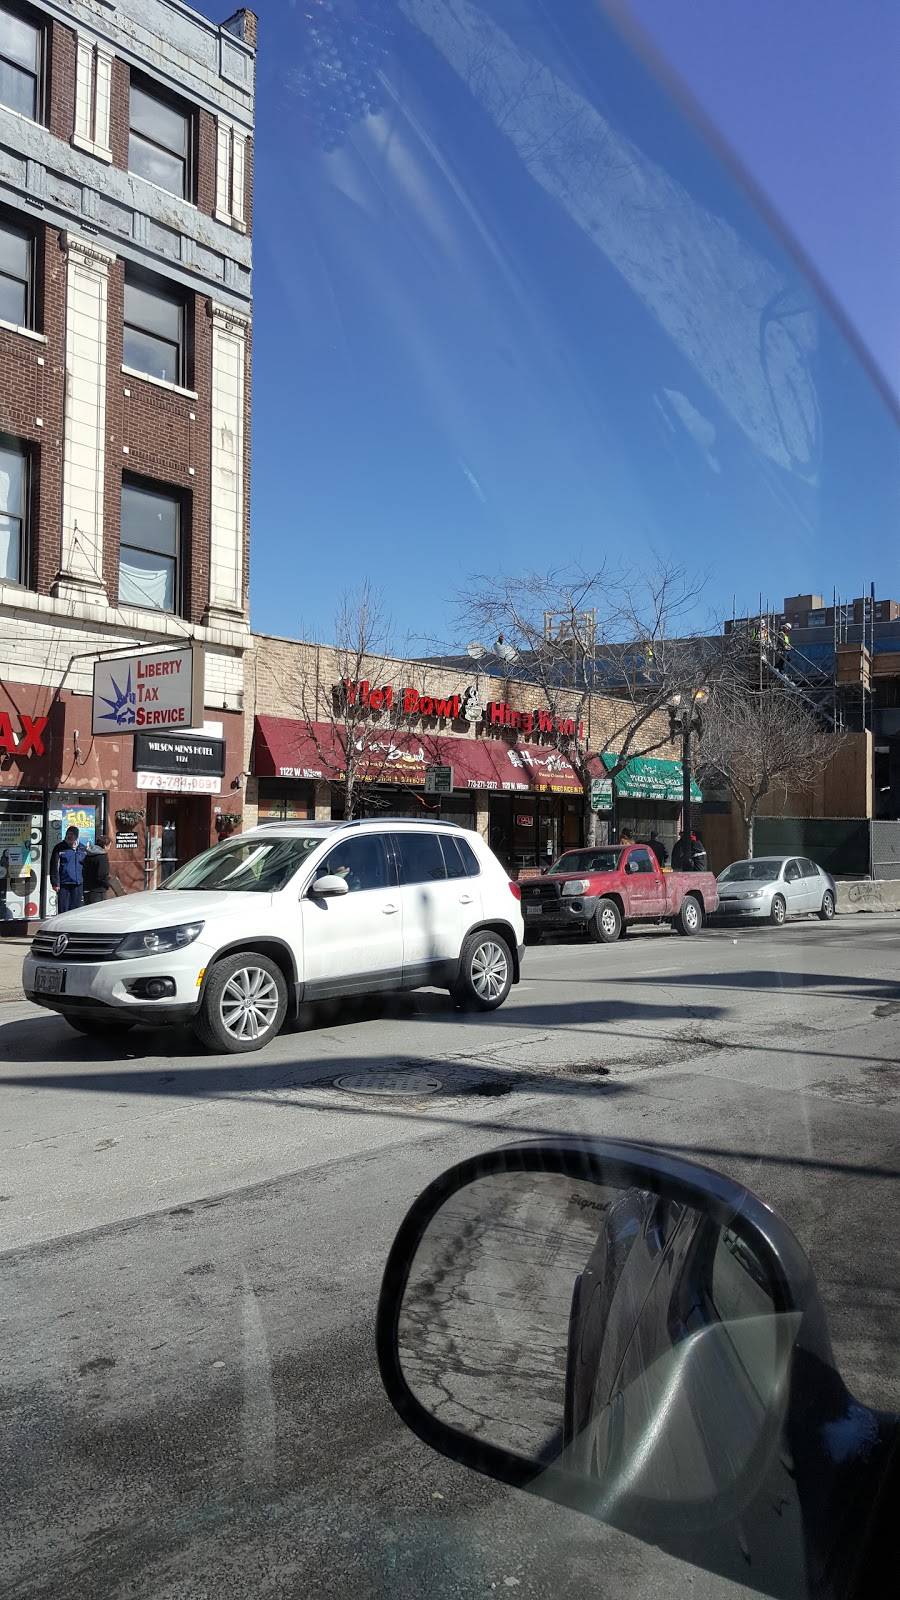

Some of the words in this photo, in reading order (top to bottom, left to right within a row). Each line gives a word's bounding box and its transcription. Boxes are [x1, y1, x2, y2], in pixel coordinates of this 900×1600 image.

[137, 660, 182, 679] LIBERTY
[137, 684, 159, 702] TAX
[402, 687, 461, 720] Bowl
[136, 707, 185, 726] SERVICE
[490, 702, 533, 736] Hing
[149, 742, 173, 752] WILSON
[194, 746, 213, 756] HOTEL
[279, 767, 293, 776] 1122
